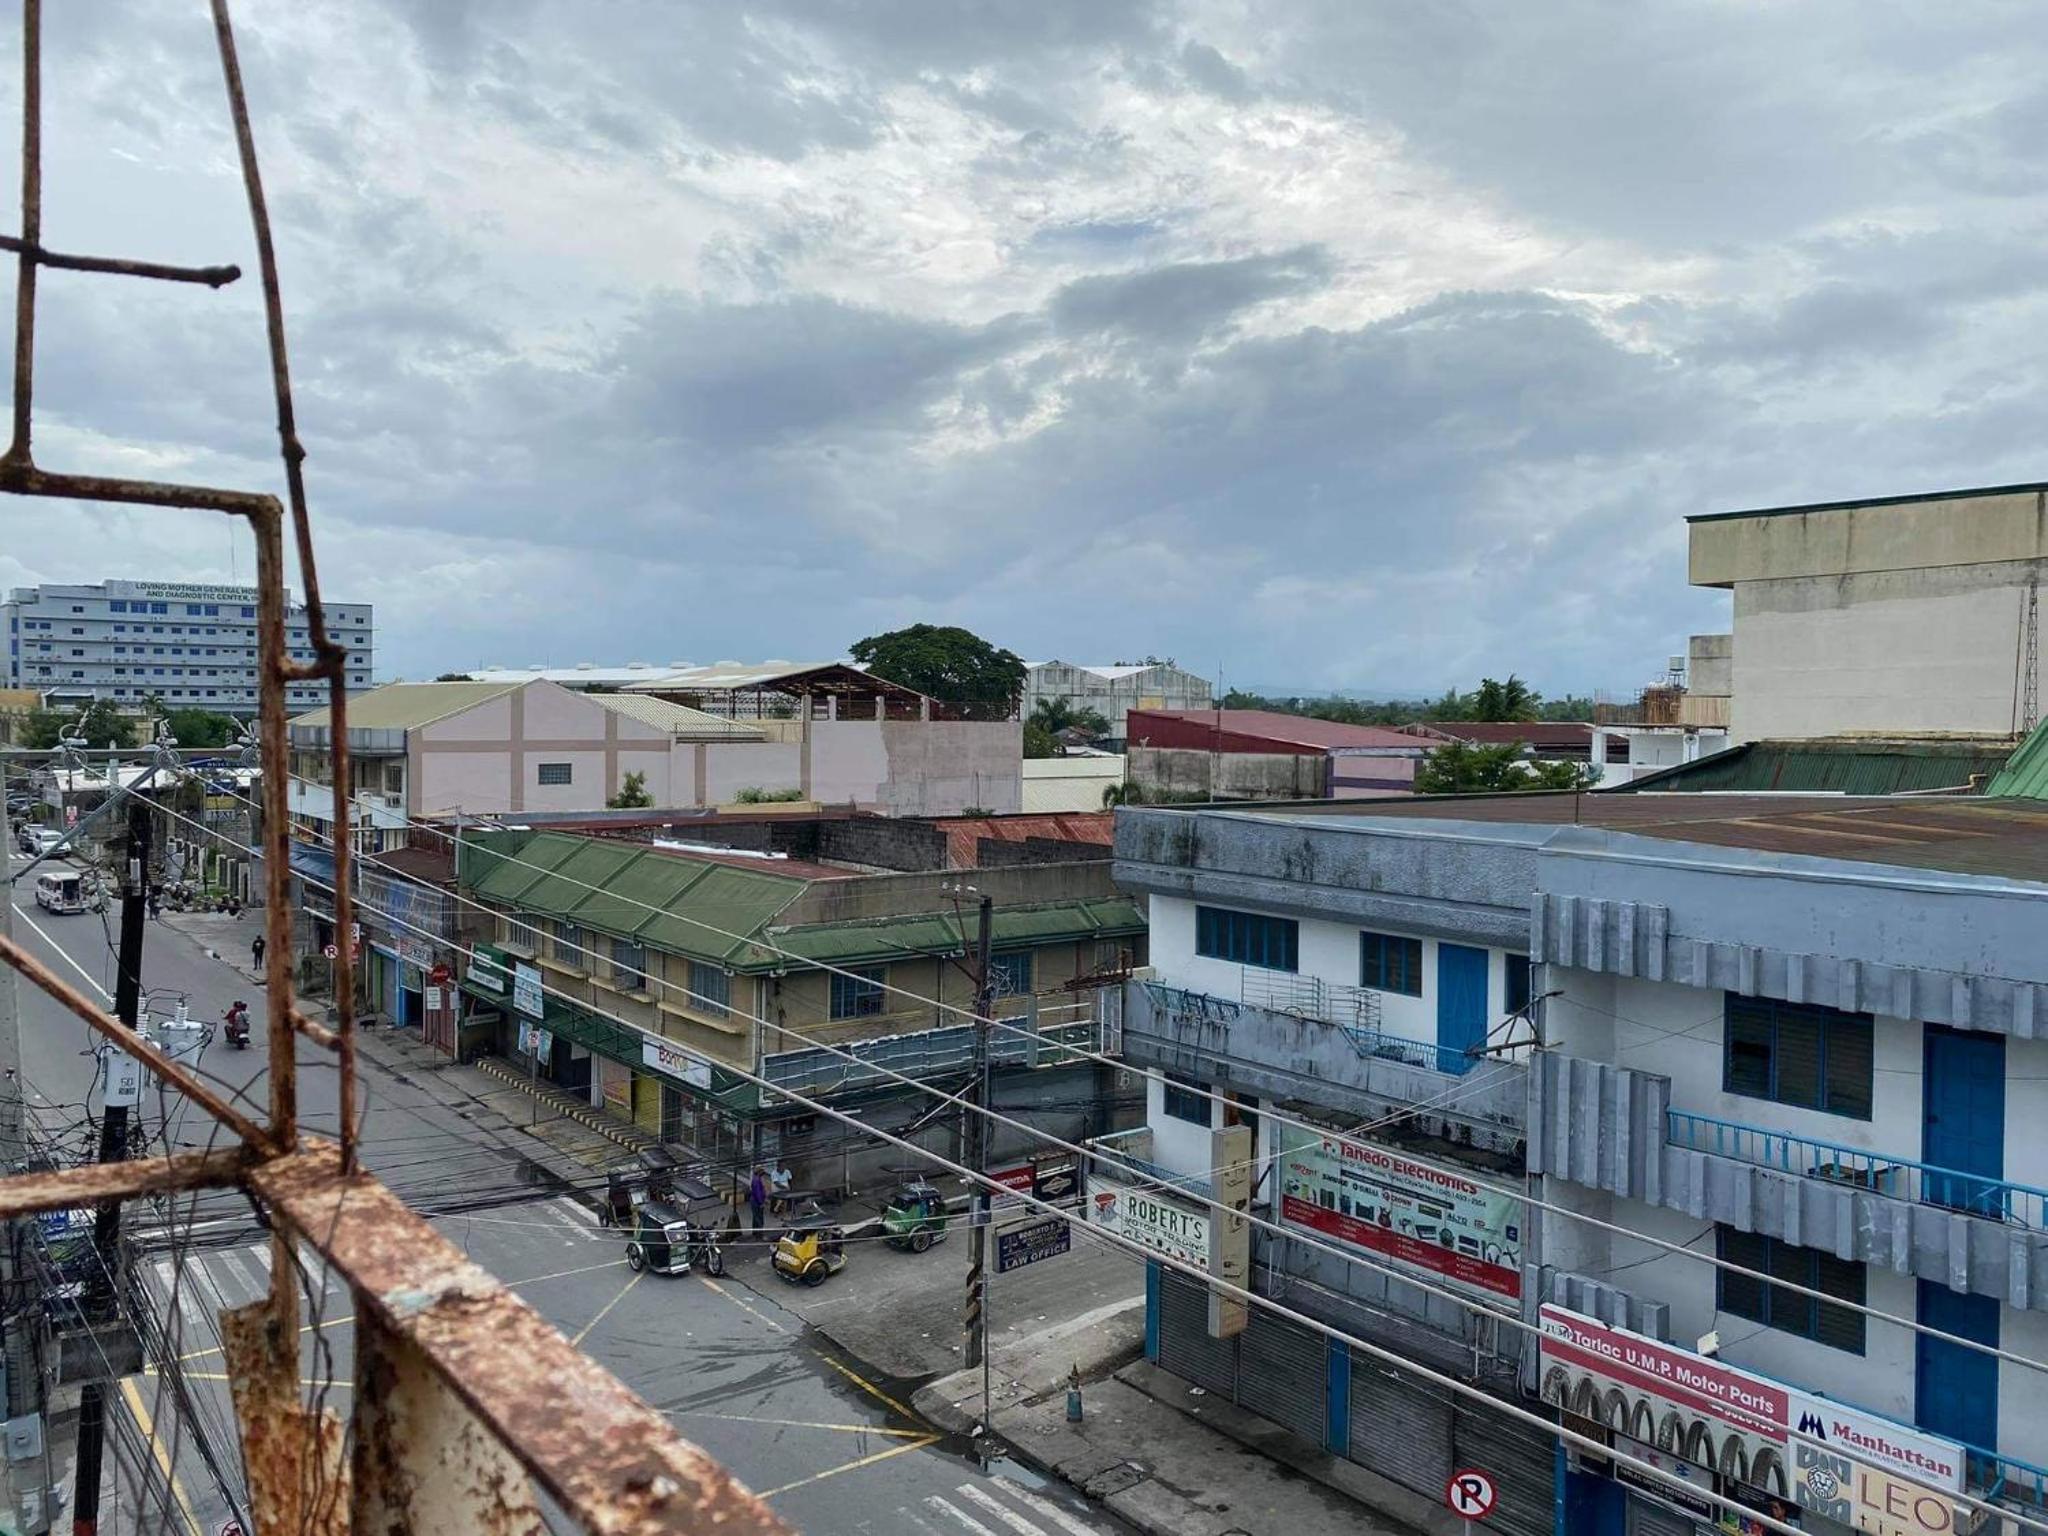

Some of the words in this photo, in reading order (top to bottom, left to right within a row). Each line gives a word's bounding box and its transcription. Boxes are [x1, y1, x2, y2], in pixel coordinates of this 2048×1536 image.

[135, 583, 167, 591] LOVING
[168, 584, 203, 592] MOTHER
[204, 586, 240, 594] GENERAL
[164, 592, 215, 600] DIAGNOSTIC
[1393, 1160, 1478, 1195] Electronics
[1128, 1196, 1203, 1240] ROBERT'S
[1004, 1256, 1028, 1270] LAW
[1030, 1242, 1068, 1261] OFFICE
[1163, 1231, 1206, 1252] TRADING
[1574, 1330, 1622, 1359] Tarlac
[1625, 1348, 1672, 1378] U.M.P.
[1676, 1366, 1725, 1396] Motor
[1729, 1385, 1775, 1414] Parts
[1832, 1421, 1953, 1478] Manhattan
[1860, 1472, 1950, 1531] LEO
